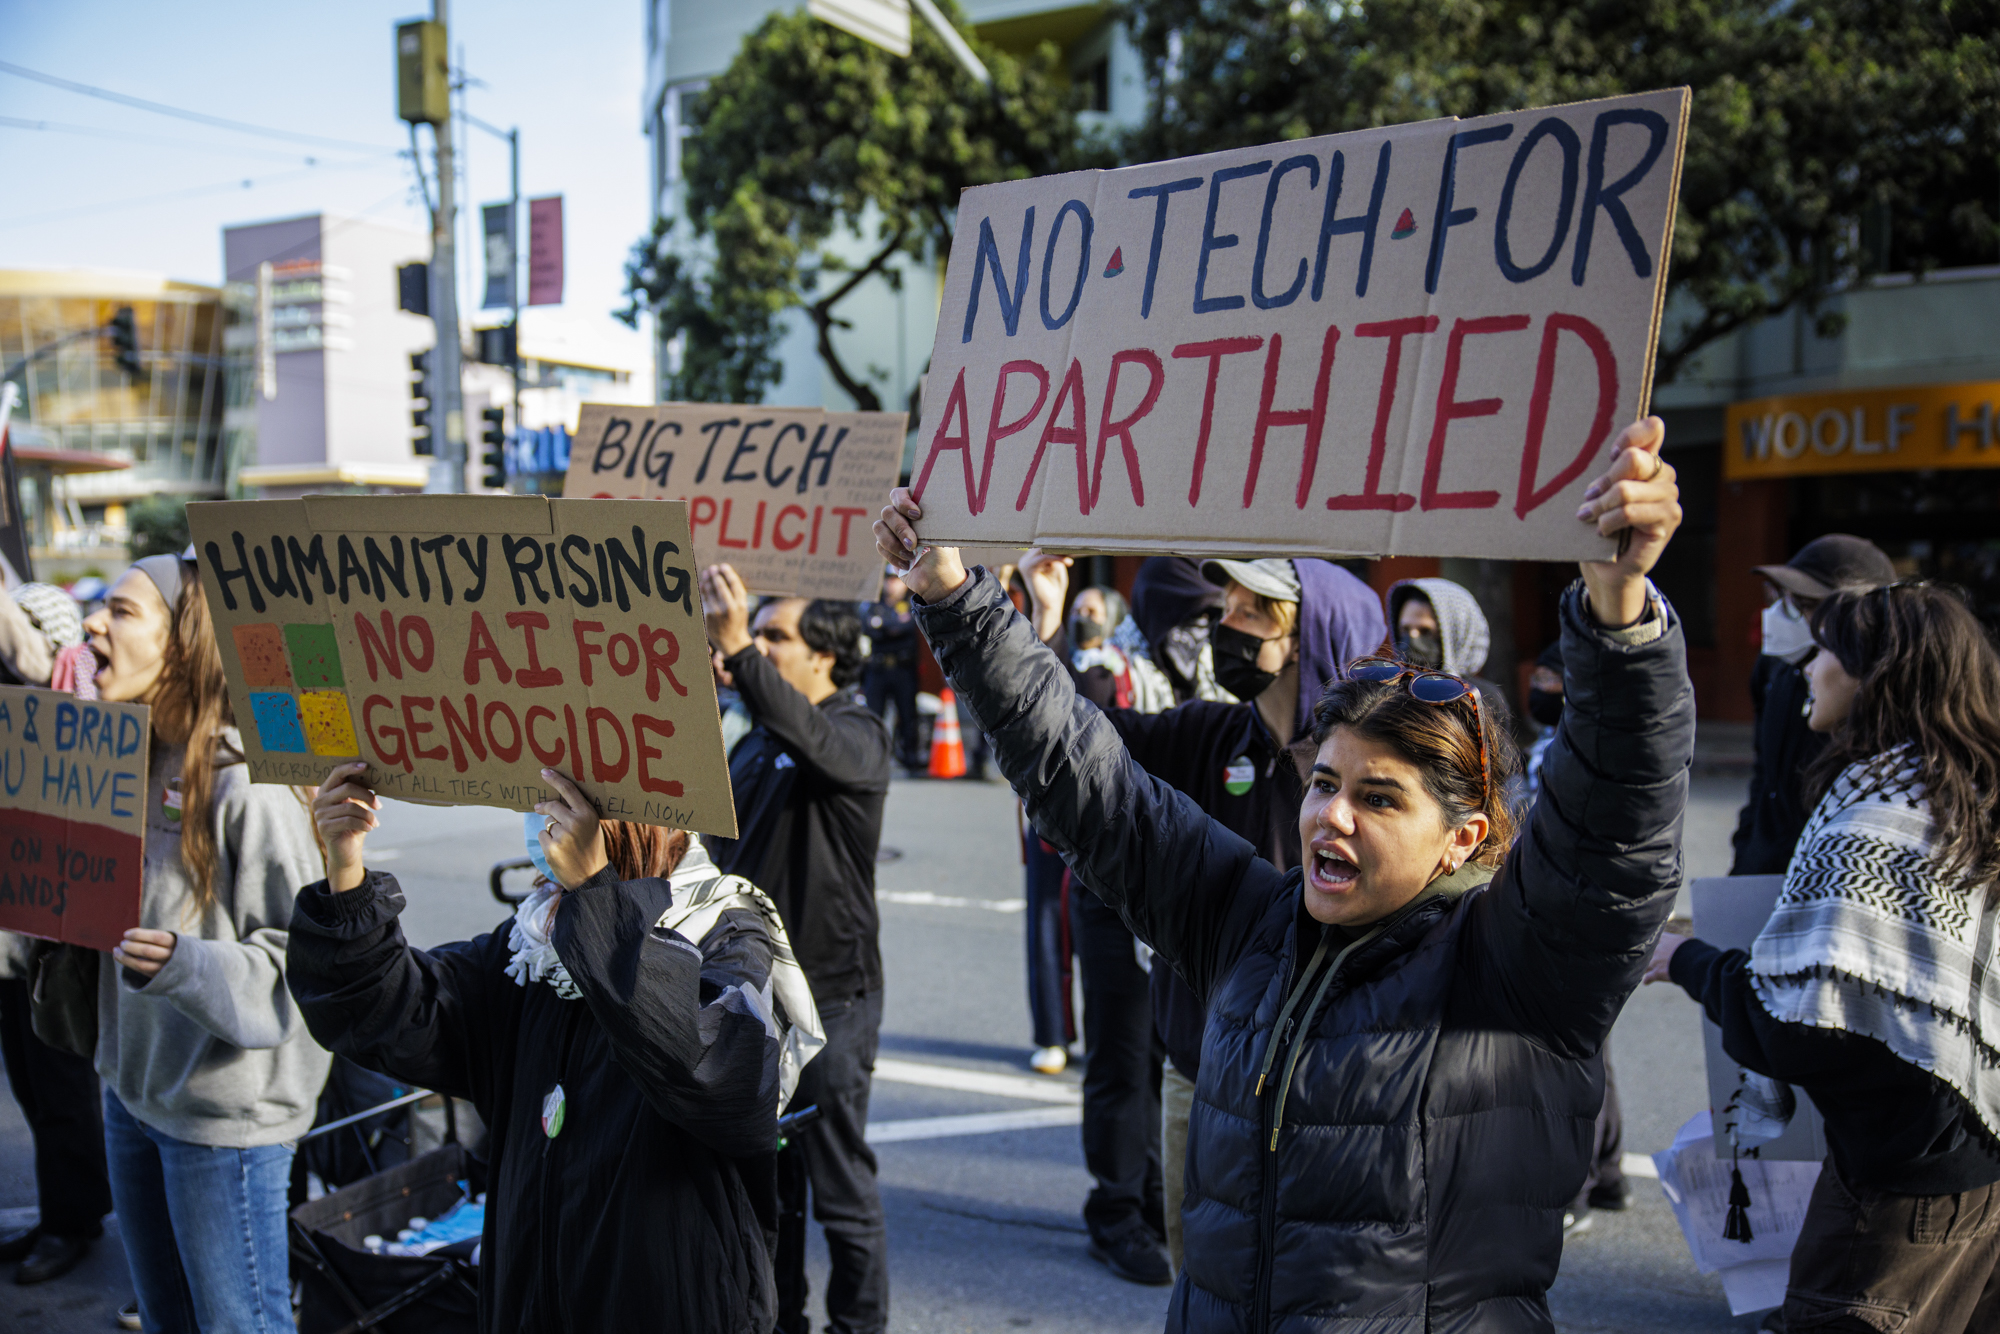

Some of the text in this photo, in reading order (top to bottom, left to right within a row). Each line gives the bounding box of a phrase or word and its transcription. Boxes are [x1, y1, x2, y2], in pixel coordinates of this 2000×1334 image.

[962, 108, 1669, 343] NO TECH FOR
[912, 312, 1619, 520] APARTHIED
[1740, 401, 2000, 460] WOOLF H
[592, 417, 682, 487] BIG
[695, 416, 849, 494] TECH
[590, 492, 868, 557] PLICIT
[204, 525, 693, 617] HUMANITY RISING
[354, 609, 689, 703] NO AI FOR
[23, 694, 41, 751] &
[55, 702, 142, 759] BRAD
[362, 693, 685, 798] GENOCIDE
[42, 754, 138, 818] HAVE
[252, 759, 338, 779] MICROSO
[370, 767, 406, 791] CUT
[412, 775, 445, 794] ALL
[448, 779, 492, 799] TIES
[499, 783, 547, 805] WITH
[643, 800, 694, 826] NOW
[10, 837, 118, 883] ON YOUR
